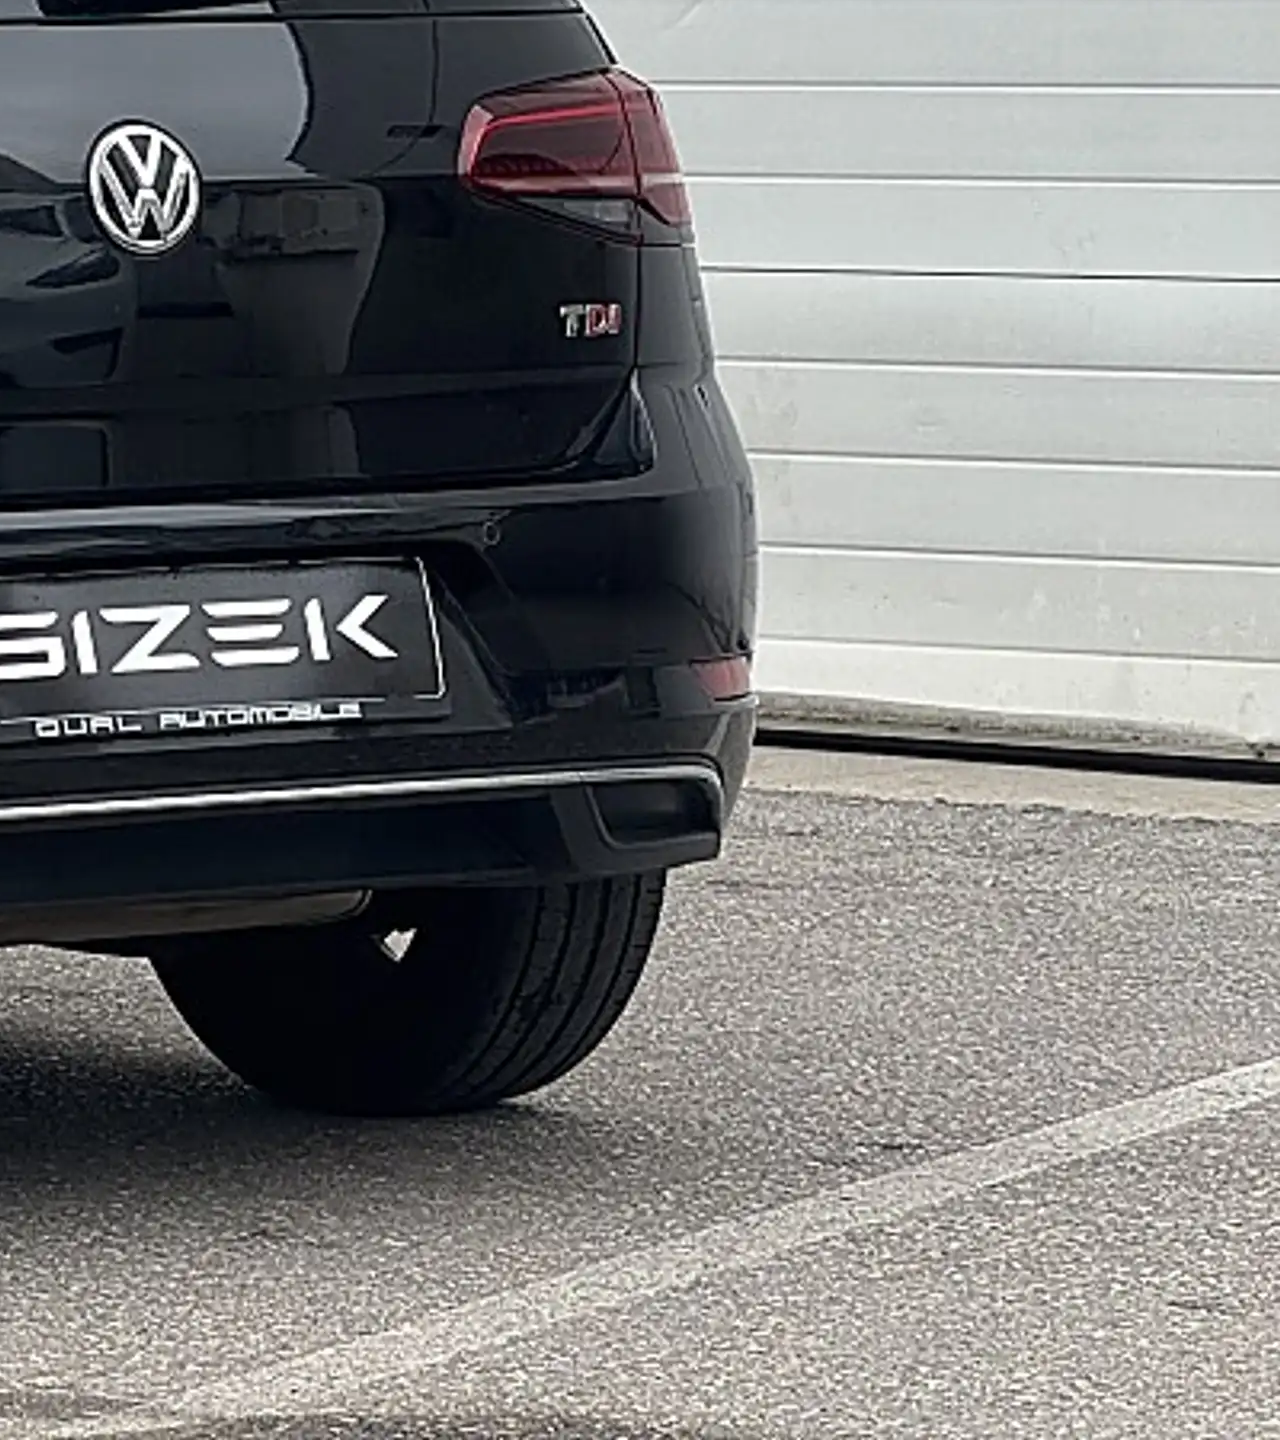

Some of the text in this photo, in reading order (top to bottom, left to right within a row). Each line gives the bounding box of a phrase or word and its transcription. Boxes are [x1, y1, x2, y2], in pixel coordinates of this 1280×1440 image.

[90, 124, 201, 254] VW
[559, 303, 622, 338] TDI
[159, 702, 363, 730] AUTOMOBILE
